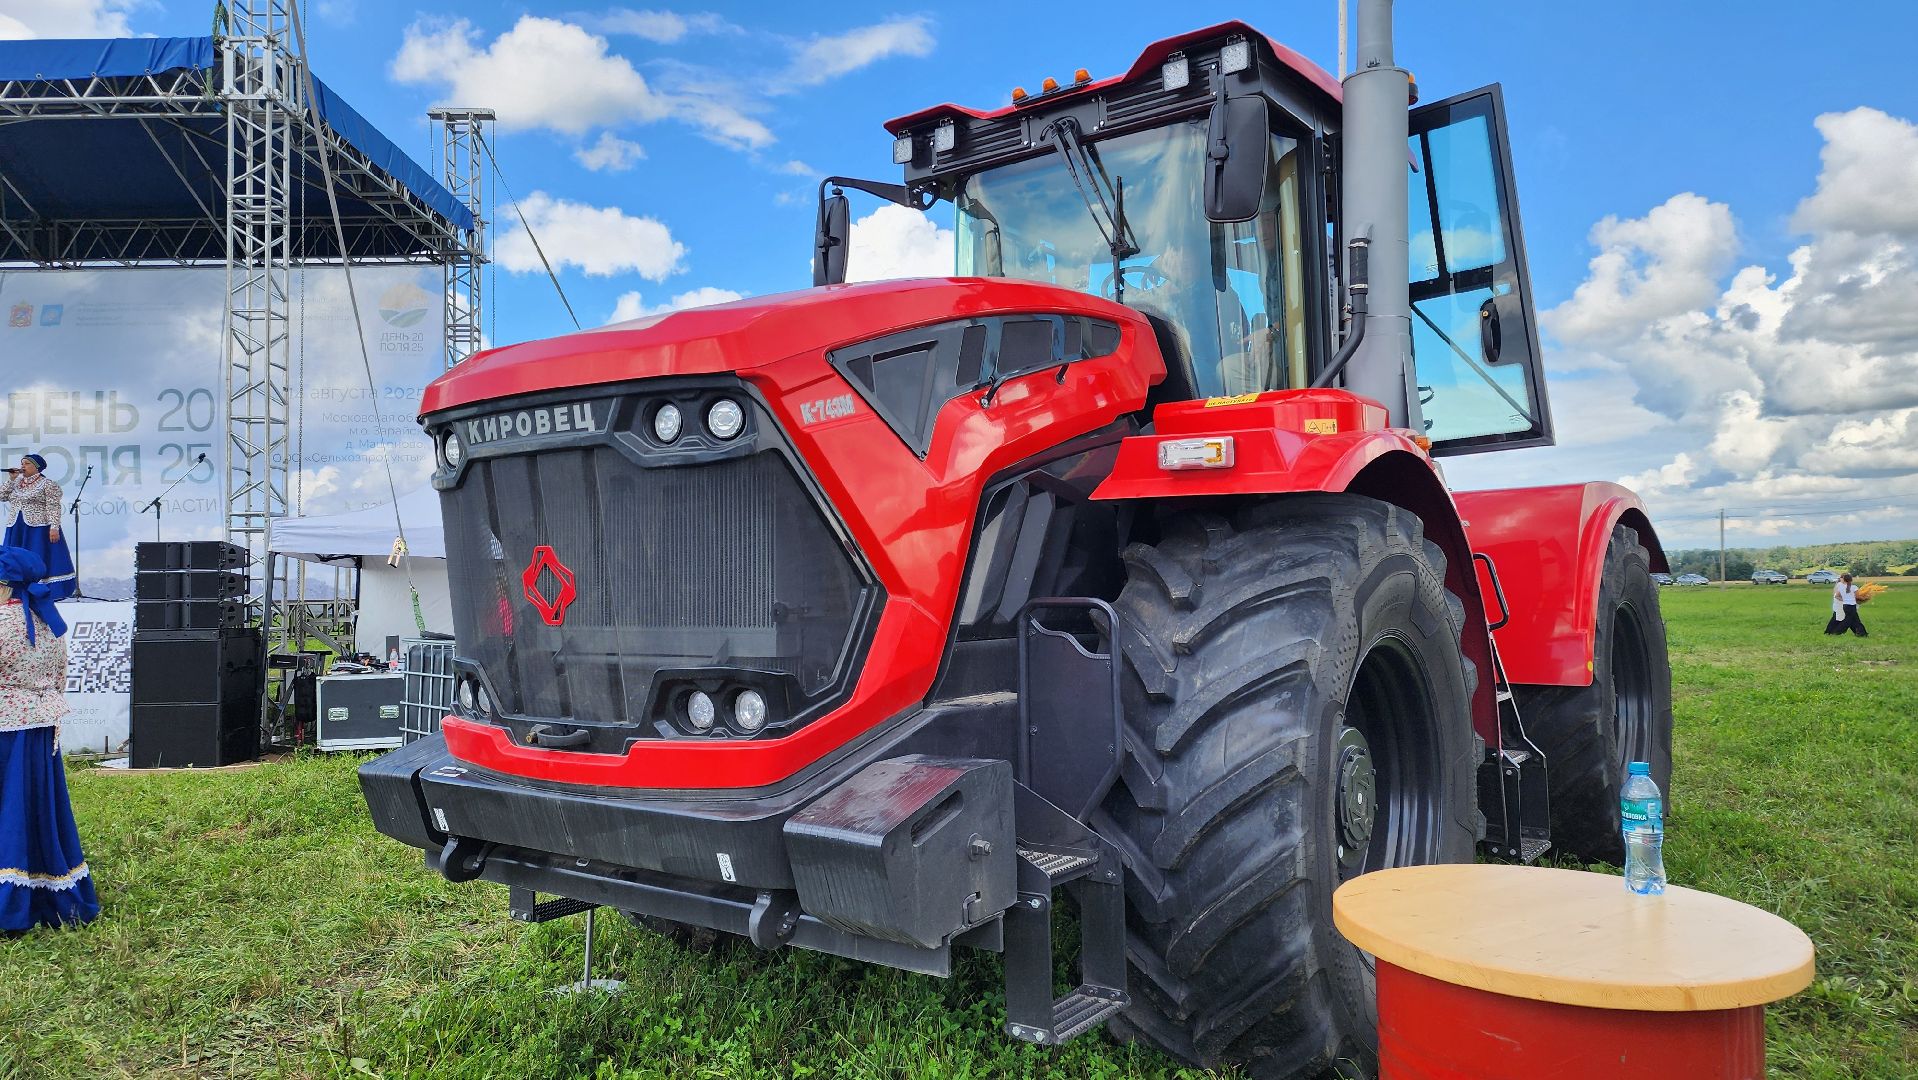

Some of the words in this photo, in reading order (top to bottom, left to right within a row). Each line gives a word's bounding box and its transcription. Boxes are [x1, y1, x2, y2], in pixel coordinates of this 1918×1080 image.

[381, 332, 409, 342] ДЕНЬ
[412, 332, 424, 342] 20
[380, 342, 409, 352] ПОЛЯ
[411, 342, 424, 352] 25
[310, 387, 378, 403] августа
[0, 390, 140, 444] ДЕНЬ
[157, 388, 216, 432] 20
[322, 412, 395, 423] Московская
[466, 402, 596, 445] КИРОВЕЦ
[158, 443, 215, 485] 25
